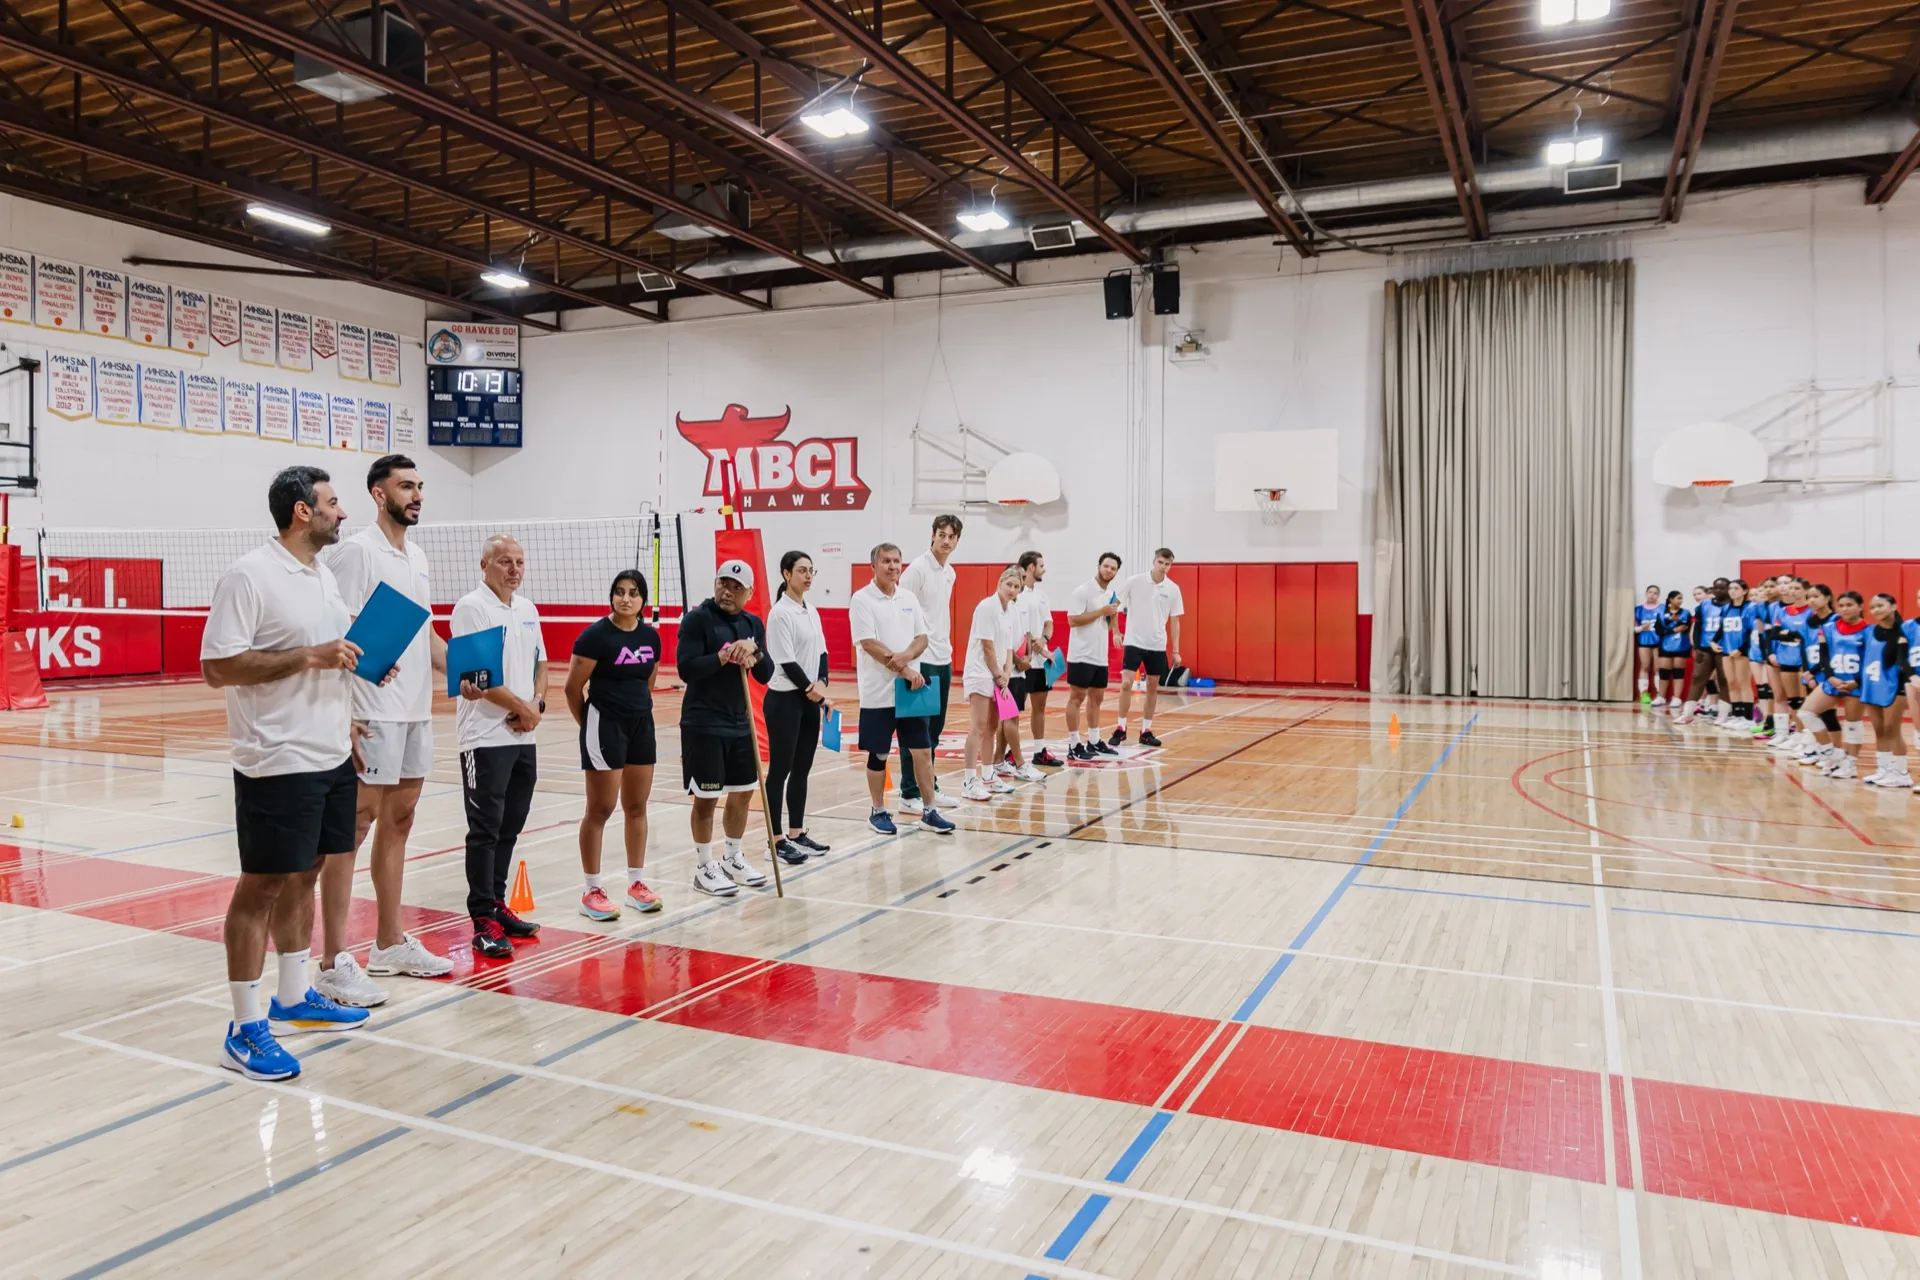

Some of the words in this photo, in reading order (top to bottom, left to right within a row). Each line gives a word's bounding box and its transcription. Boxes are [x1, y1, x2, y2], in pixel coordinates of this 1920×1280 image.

[0, 252, 28, 267] HSAA
[39, 262, 76, 276] MHSAA
[38, 272, 76, 285] PROVINCIAL
[87, 269, 122, 284] MHSAA
[132, 282, 165, 296] MHSAA
[38, 290, 76, 302] VOLLEYBALL
[131, 291, 166, 304] PROVINCIAL
[174, 290, 206, 303] MHSAA
[42, 300, 74, 310] FINALISTS
[132, 308, 166, 320] VOLLEYBALL
[244, 305, 274, 318] MHSAA
[131, 316, 165, 327] CHAMPIONS
[282, 312, 308, 324] MHSAA
[452, 324, 463, 333] GO
[465, 326, 500, 335] HAWKS
[502, 328, 516, 336] GO!
[100, 360, 134, 373] MHSAA
[100, 370, 134, 380] PROVINCIAL
[145, 367, 177, 379] MHSAA
[144, 376, 176, 386] PROVINCIAL
[188, 374, 218, 386] MHSAA
[458, 372, 502, 393] 10:13
[54, 387, 86, 396] VOLLEYBALL
[264, 385, 290, 396] MHSAA
[299, 391, 324, 401] MHSAA
[56, 394, 84, 404] CHAMPIONS
[434, 394, 452, 402] HOME
[706, 441, 859, 490] MBCI
[743, 492, 855, 508] HAWKS
[1723, 616, 1742, 632] 50
[1864, 660, 1882, 682] 4
